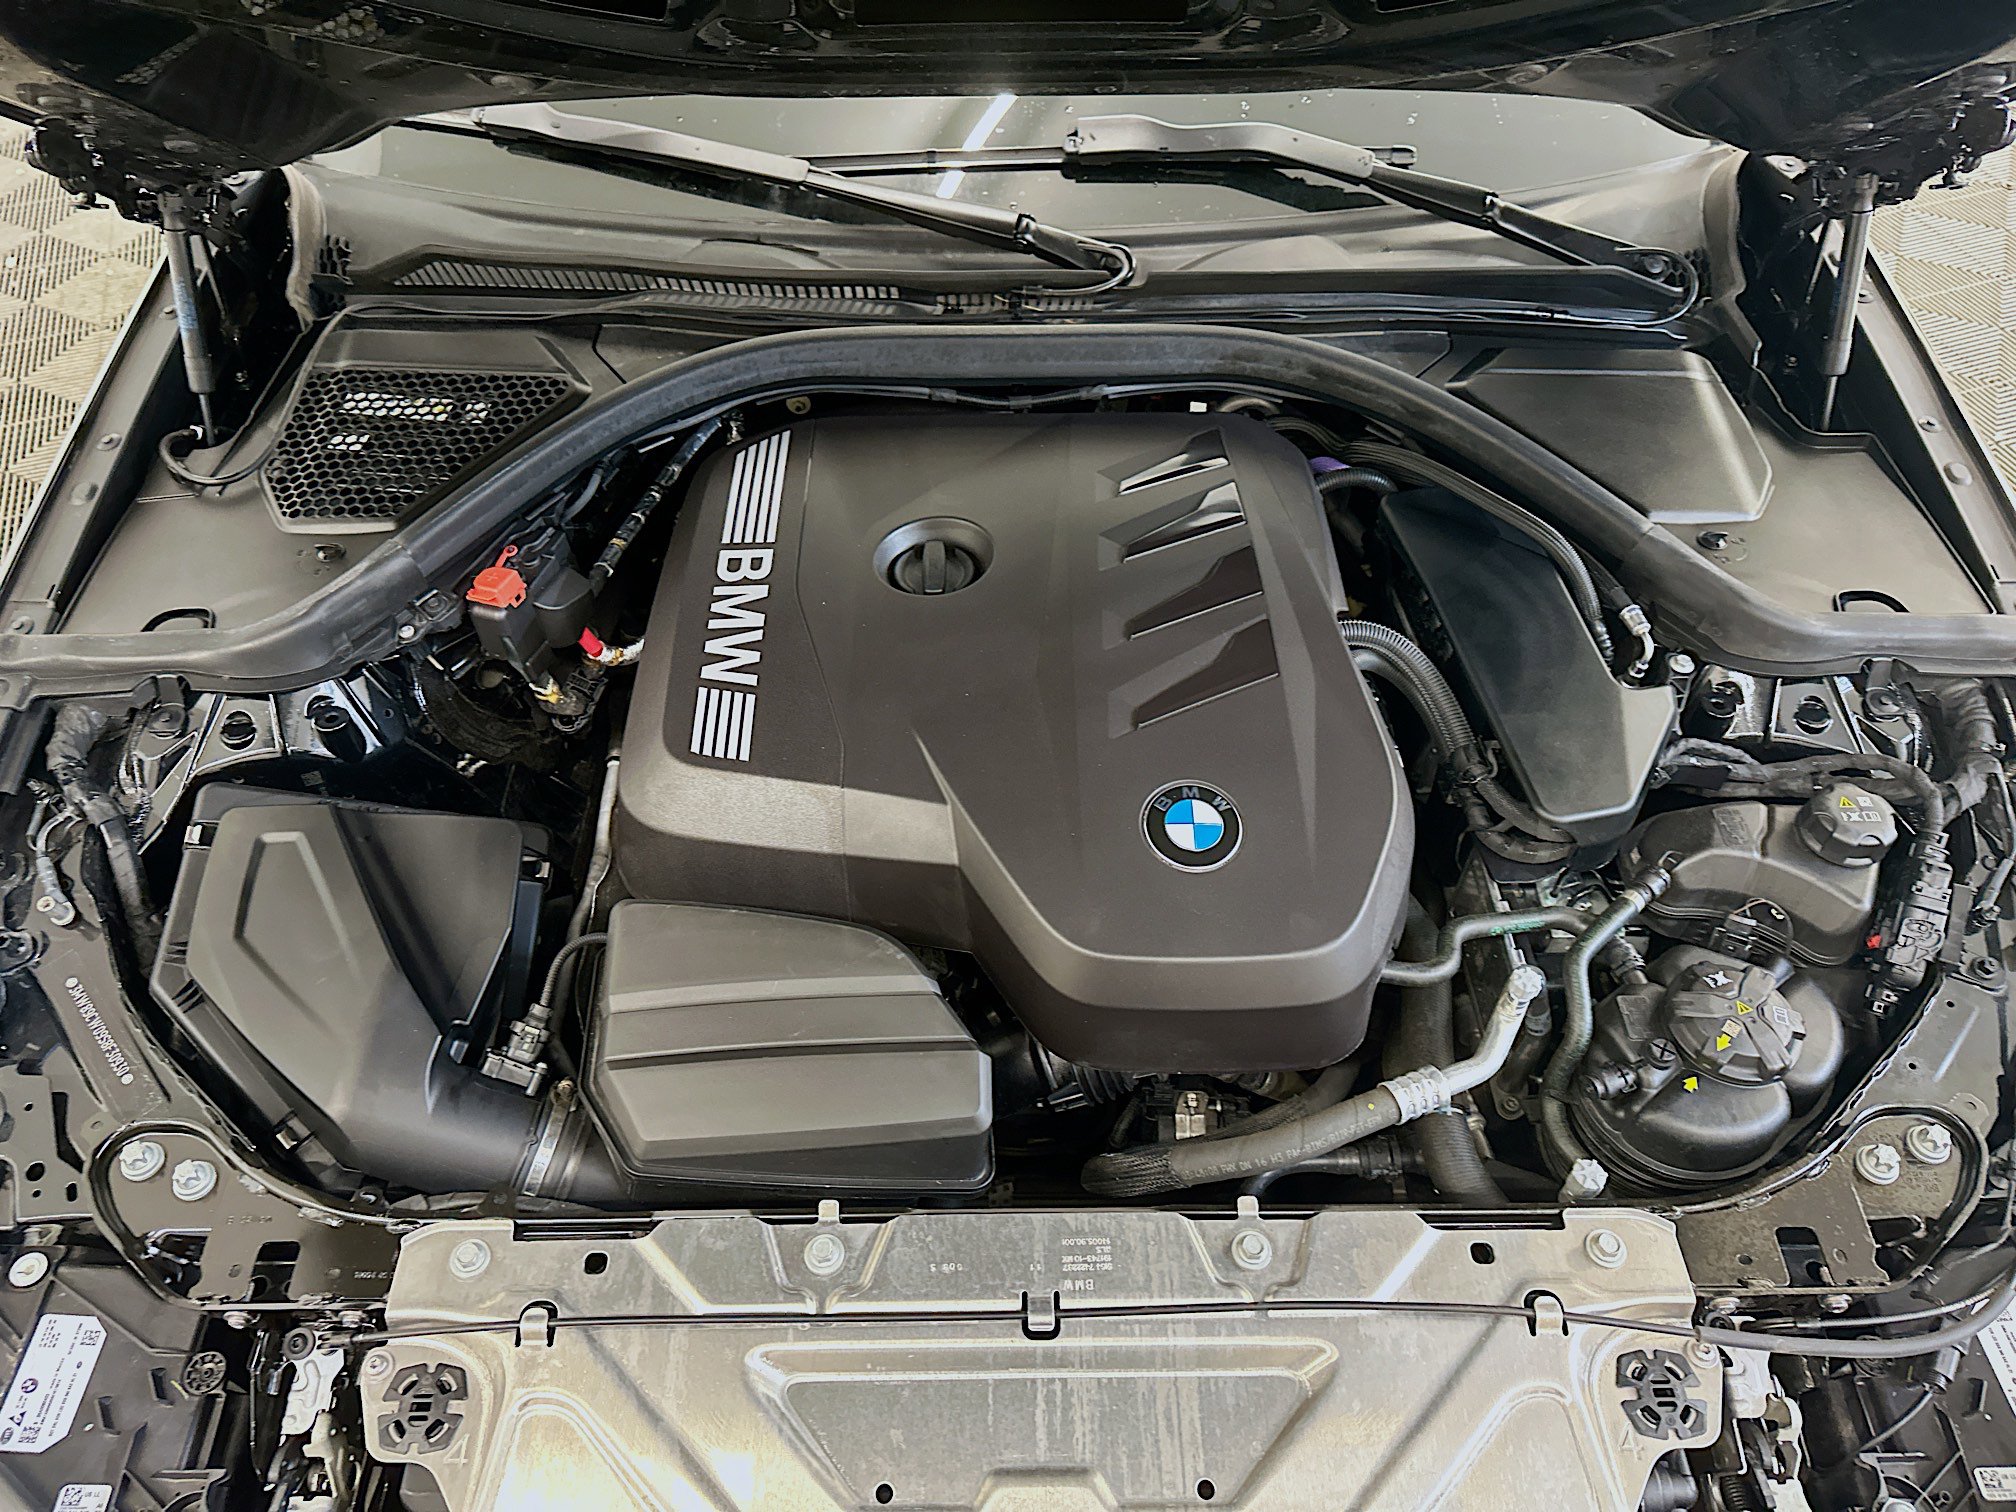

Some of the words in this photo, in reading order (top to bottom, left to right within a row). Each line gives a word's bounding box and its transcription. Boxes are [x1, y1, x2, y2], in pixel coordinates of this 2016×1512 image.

[700, 549, 774, 686] BMW
[1153, 786, 1232, 812] BMW
[1063, 1279, 1094, 1290] BMW
[442, 1433, 469, 1468] 4
